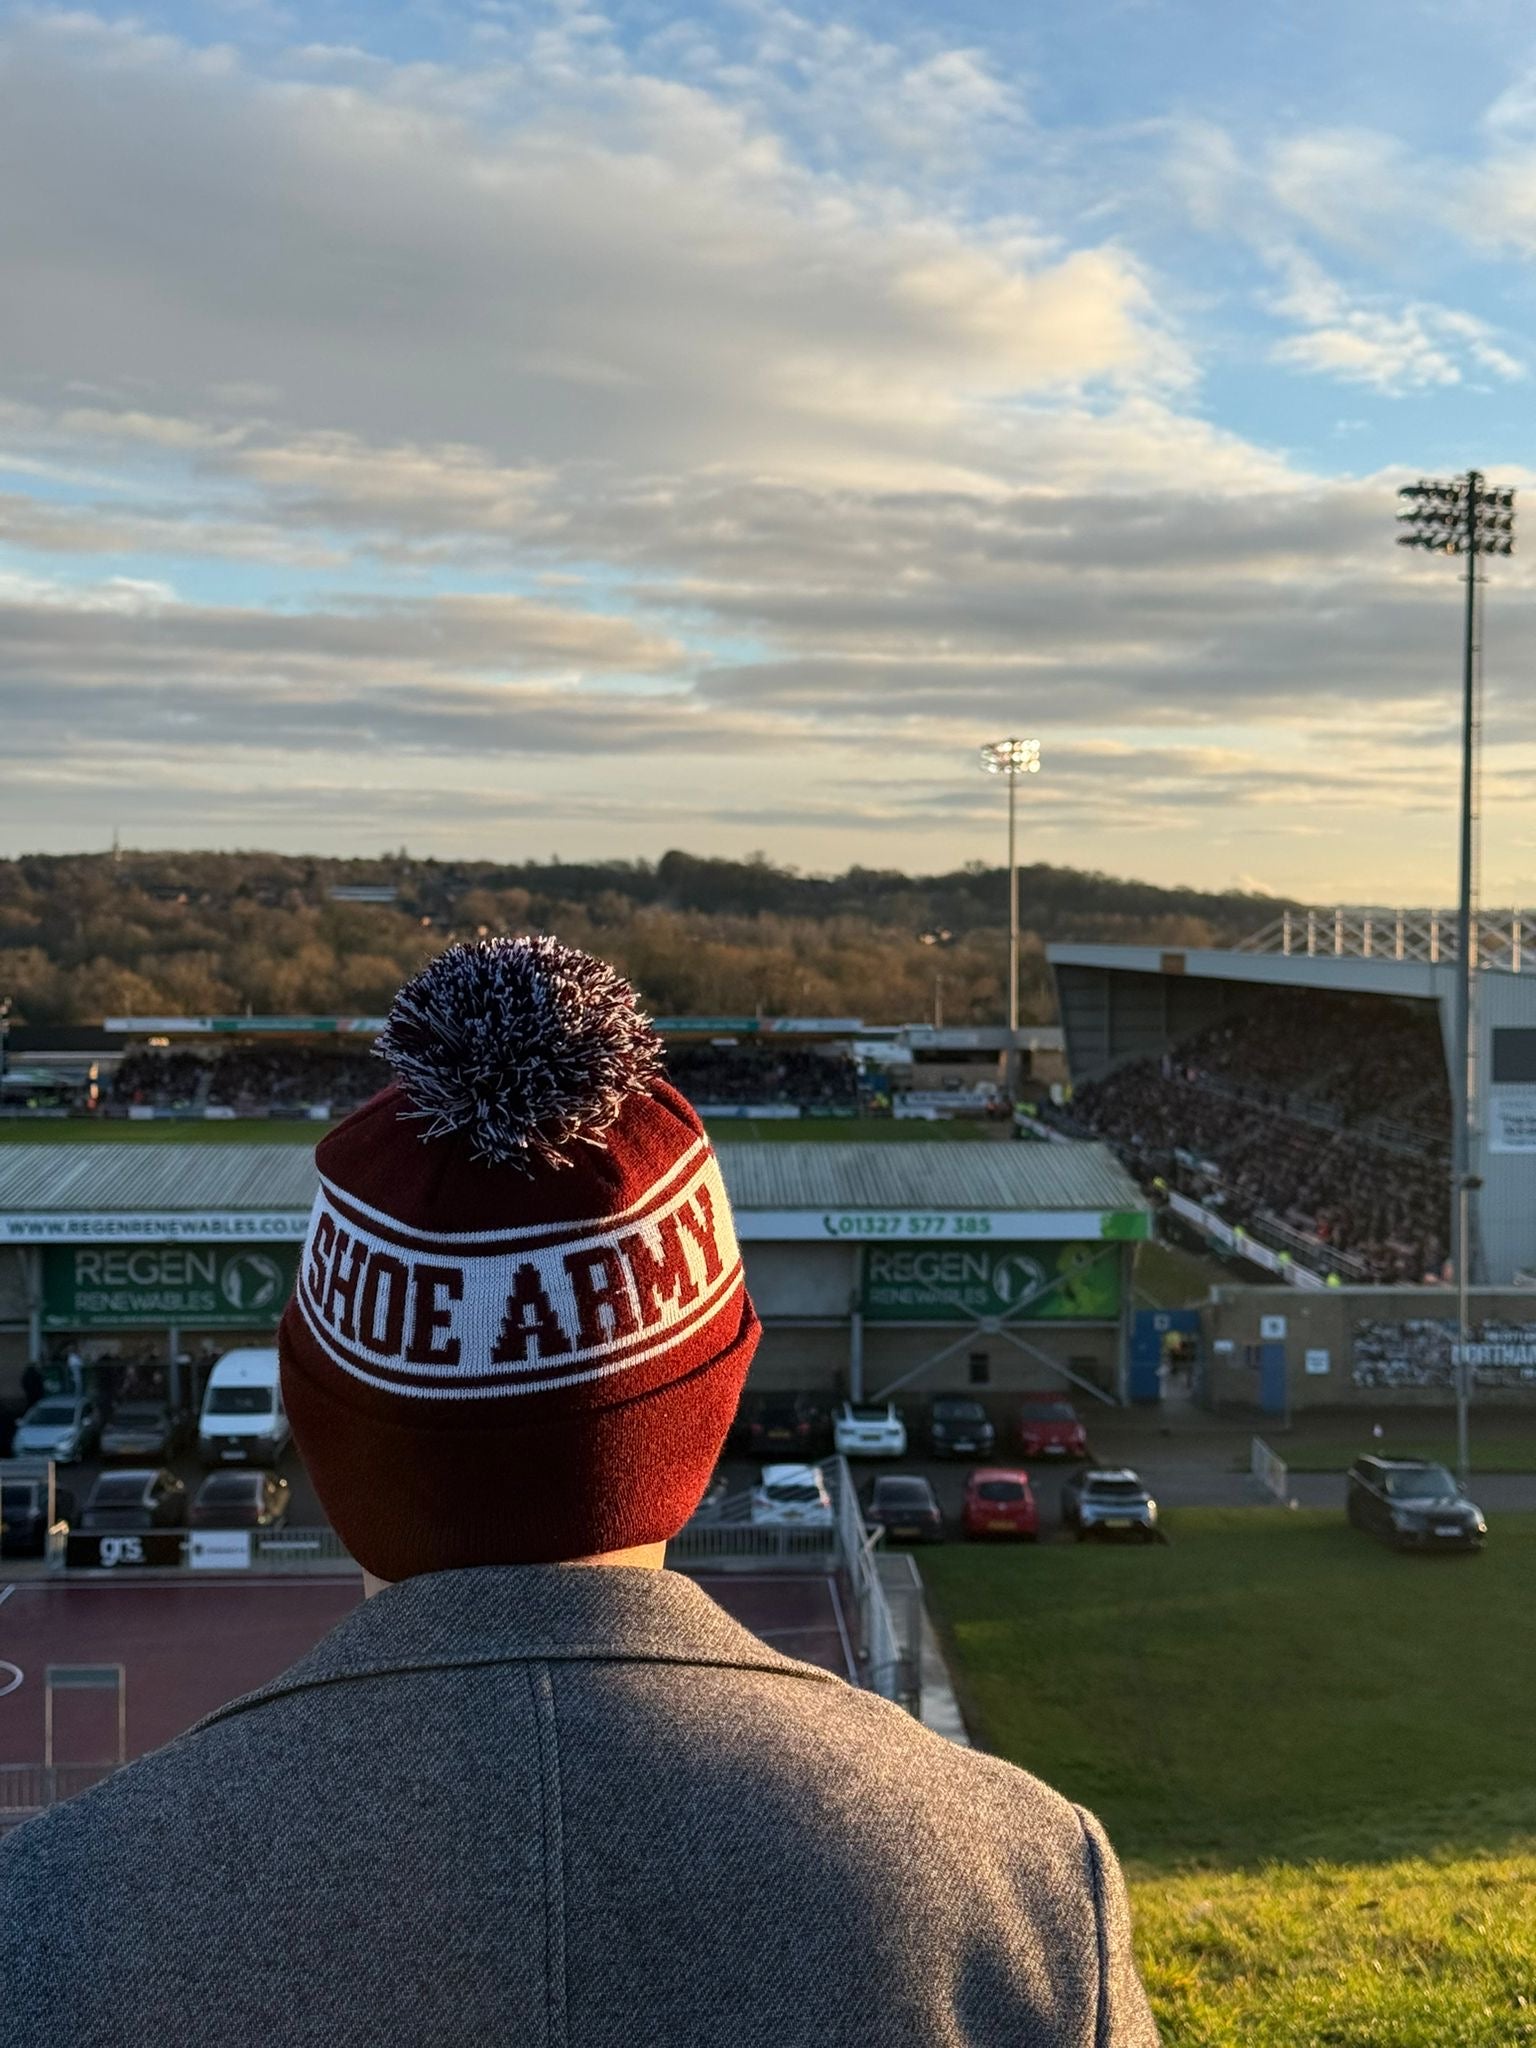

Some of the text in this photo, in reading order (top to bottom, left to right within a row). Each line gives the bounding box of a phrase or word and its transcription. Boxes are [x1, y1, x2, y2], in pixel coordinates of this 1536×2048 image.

[839, 1216, 991, 1234] 01327 577 385
[75, 1250, 217, 1286] REGEN
[308, 1183, 723, 1365] SHOE ARMY
[869, 1252, 990, 1282] REGEN
[75, 1290, 216, 1312] RENEWABLES
[869, 1287, 987, 1304] RENEWABLES
[100, 1537, 146, 1566] grs
